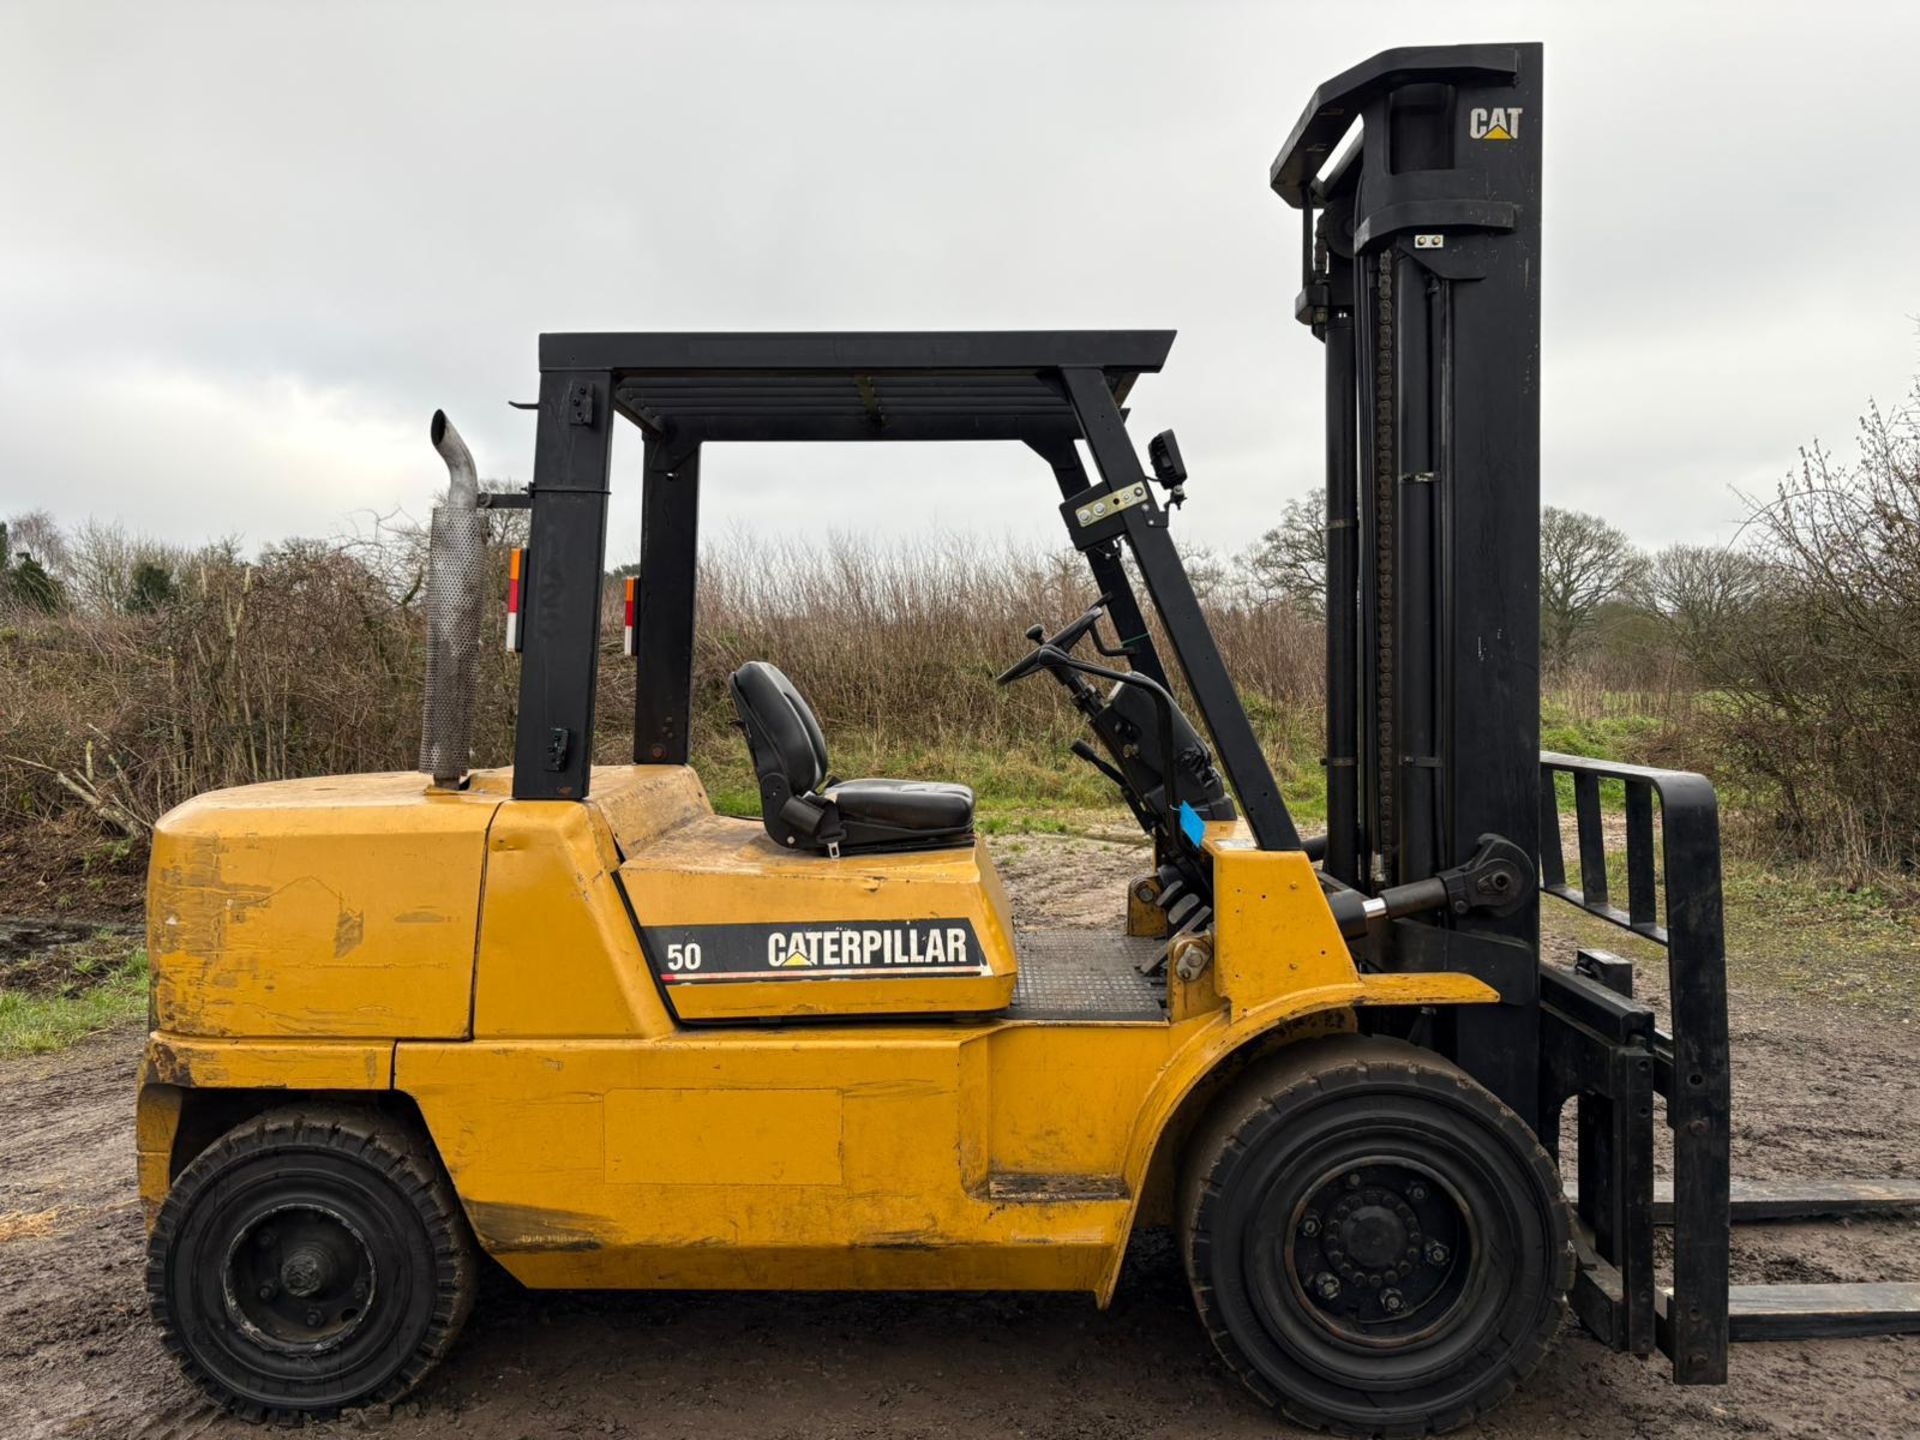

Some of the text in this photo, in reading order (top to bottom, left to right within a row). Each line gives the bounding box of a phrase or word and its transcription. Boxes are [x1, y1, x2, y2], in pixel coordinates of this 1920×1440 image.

[1470, 108, 1523, 140] CAT
[667, 928, 968, 970] 50 CATERPILLAR
